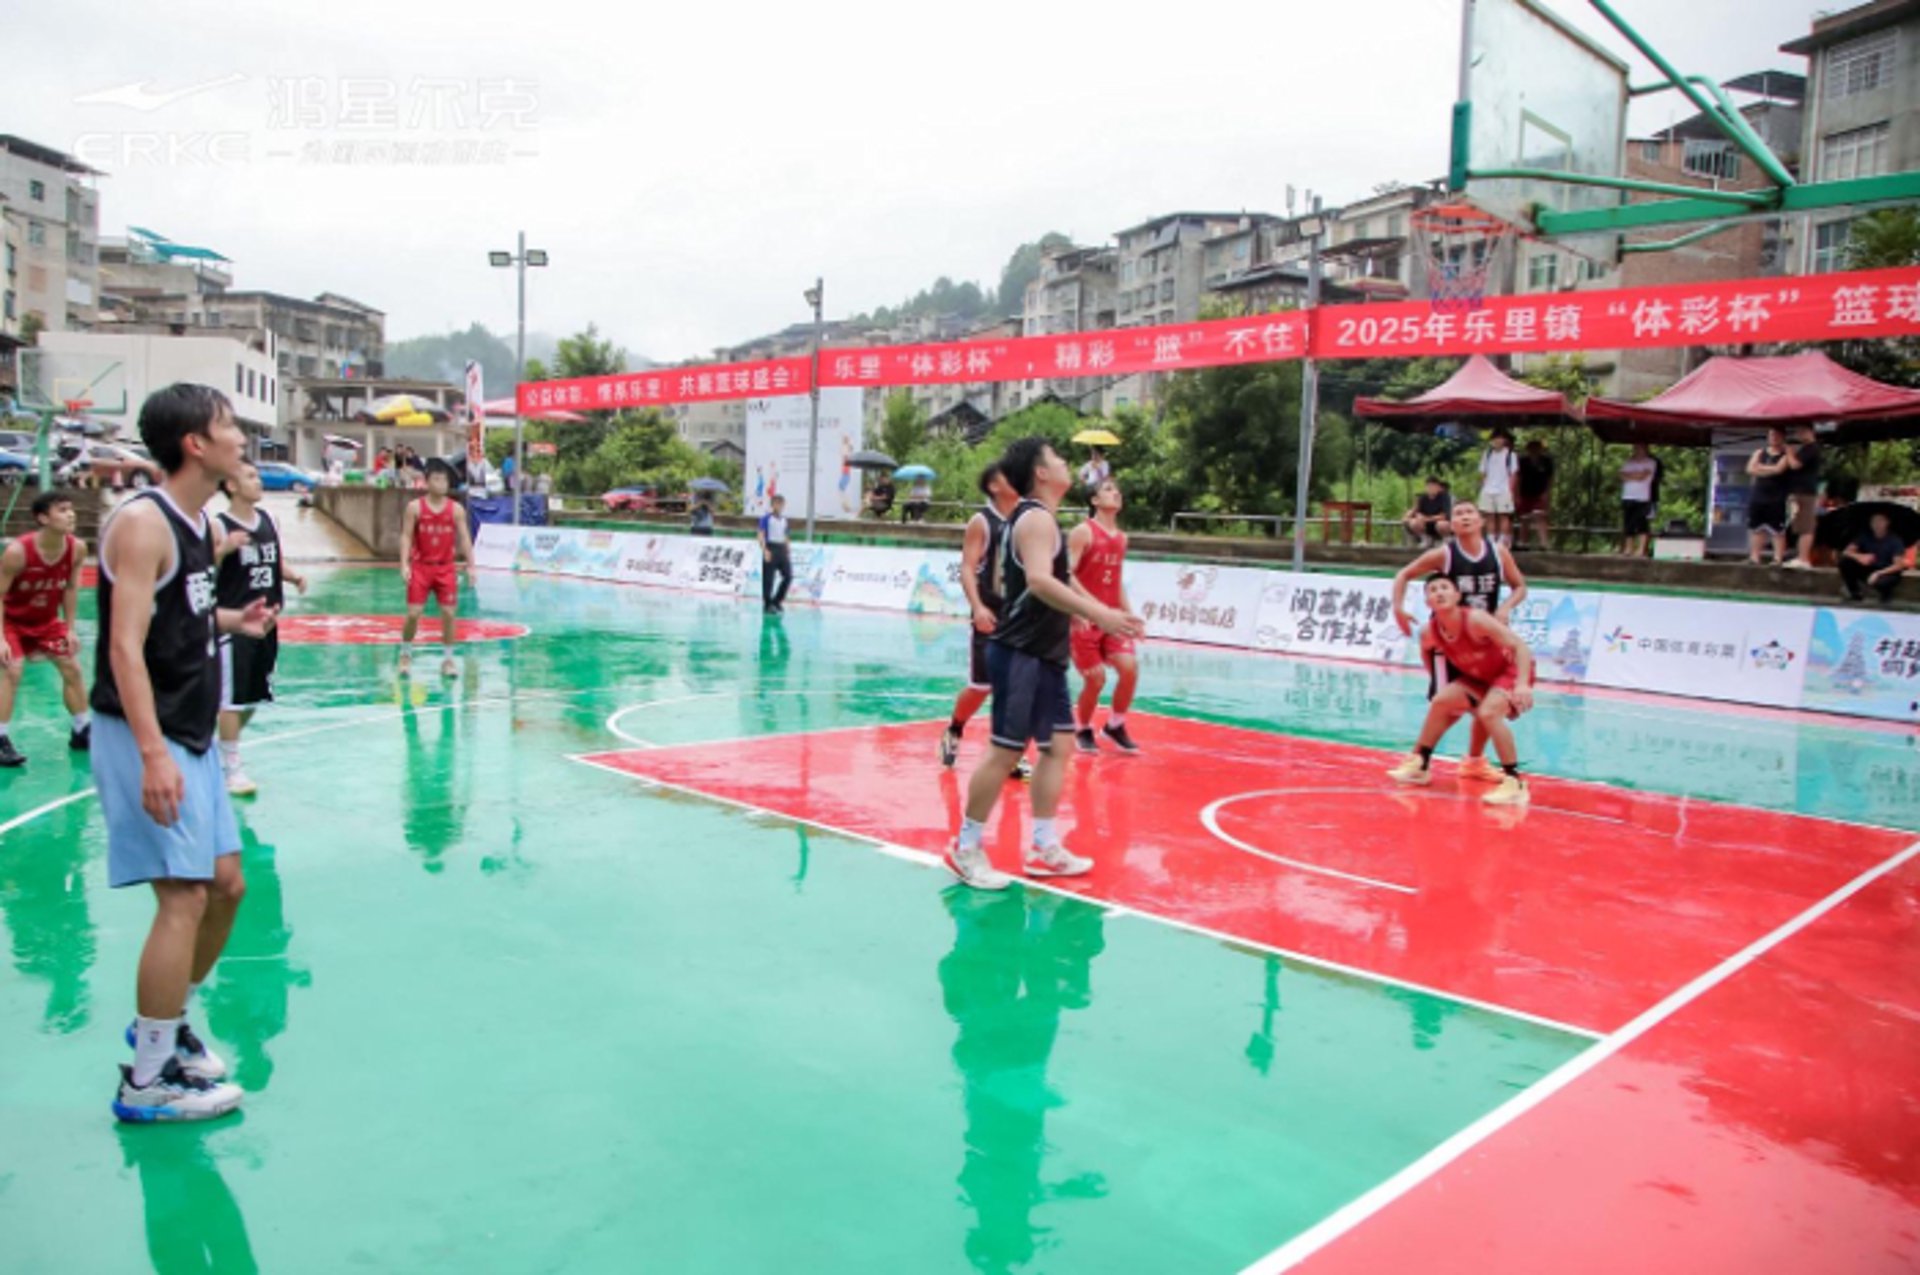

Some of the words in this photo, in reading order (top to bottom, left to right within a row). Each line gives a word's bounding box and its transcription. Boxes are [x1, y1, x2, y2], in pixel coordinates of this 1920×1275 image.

[249, 566, 273, 590] 23
[1297, 612, 1372, 645] 合作社
